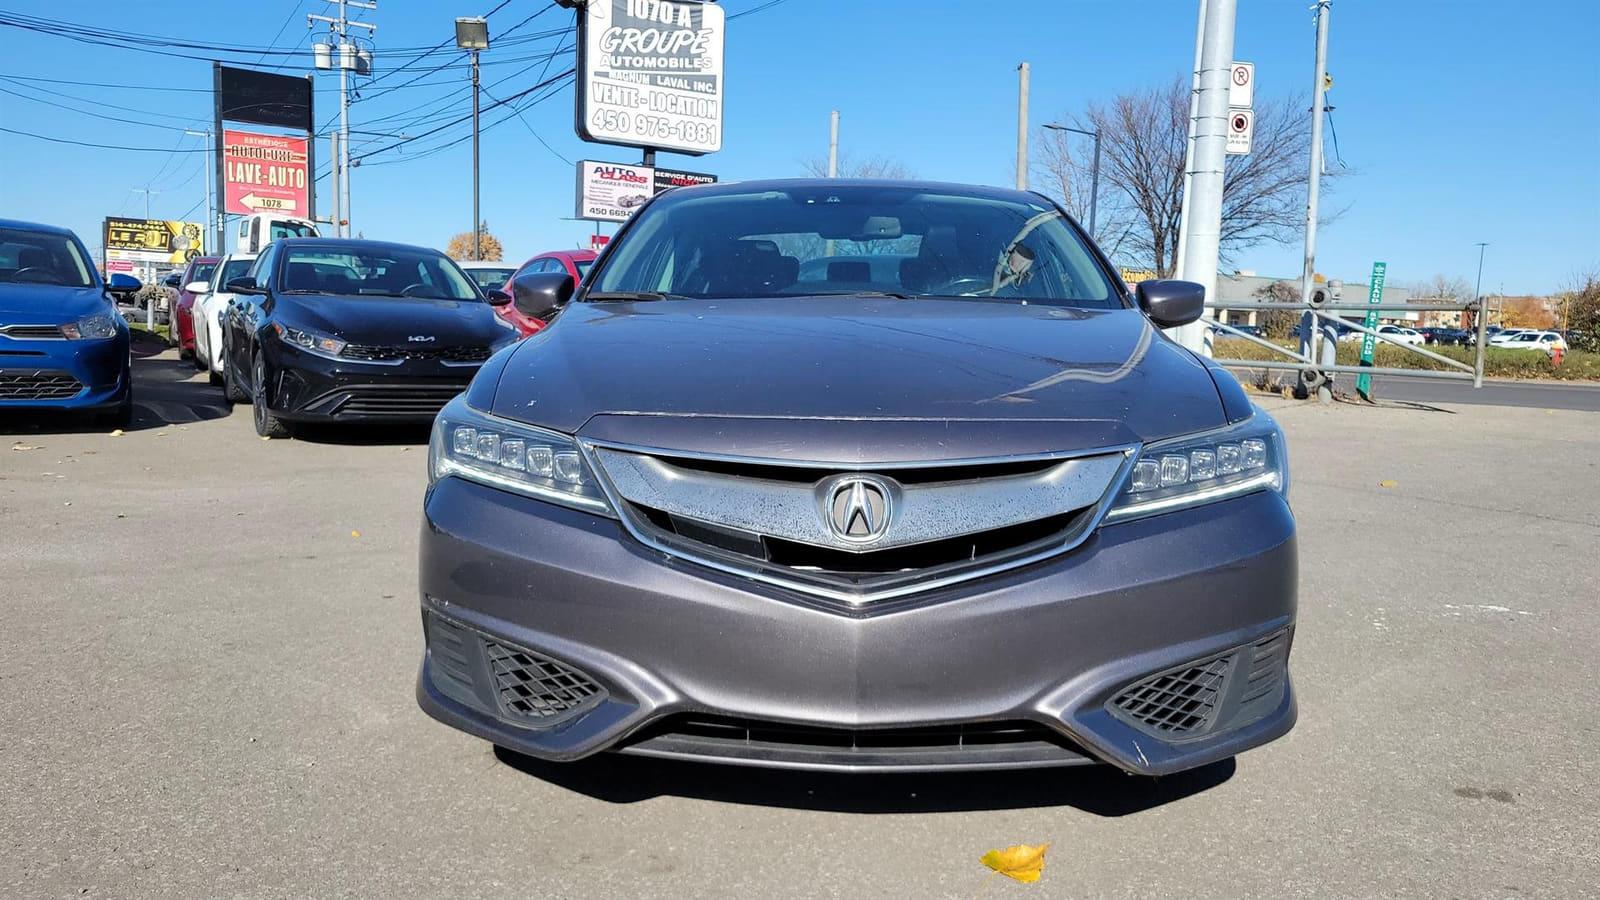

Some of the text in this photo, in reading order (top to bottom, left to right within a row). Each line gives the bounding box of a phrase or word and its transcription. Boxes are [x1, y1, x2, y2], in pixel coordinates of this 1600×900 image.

[599, 26, 714, 54] GROUPE
[600, 55, 713, 69] AUTOMOBILES
[609, 71, 716, 93] MAGNUM LAVAL INC.
[592, 108, 717, 145] 450 975-1881
[228, 161, 305, 189] LAVE-AUTO
[593, 166, 636, 177] AUTO
[600, 172, 648, 183] CLASS
[655, 171, 714, 183] SERVICE D'AUTO
[262, 199, 282, 208] 1078
[589, 207, 607, 215] 450
[111, 231, 130, 241] LE
